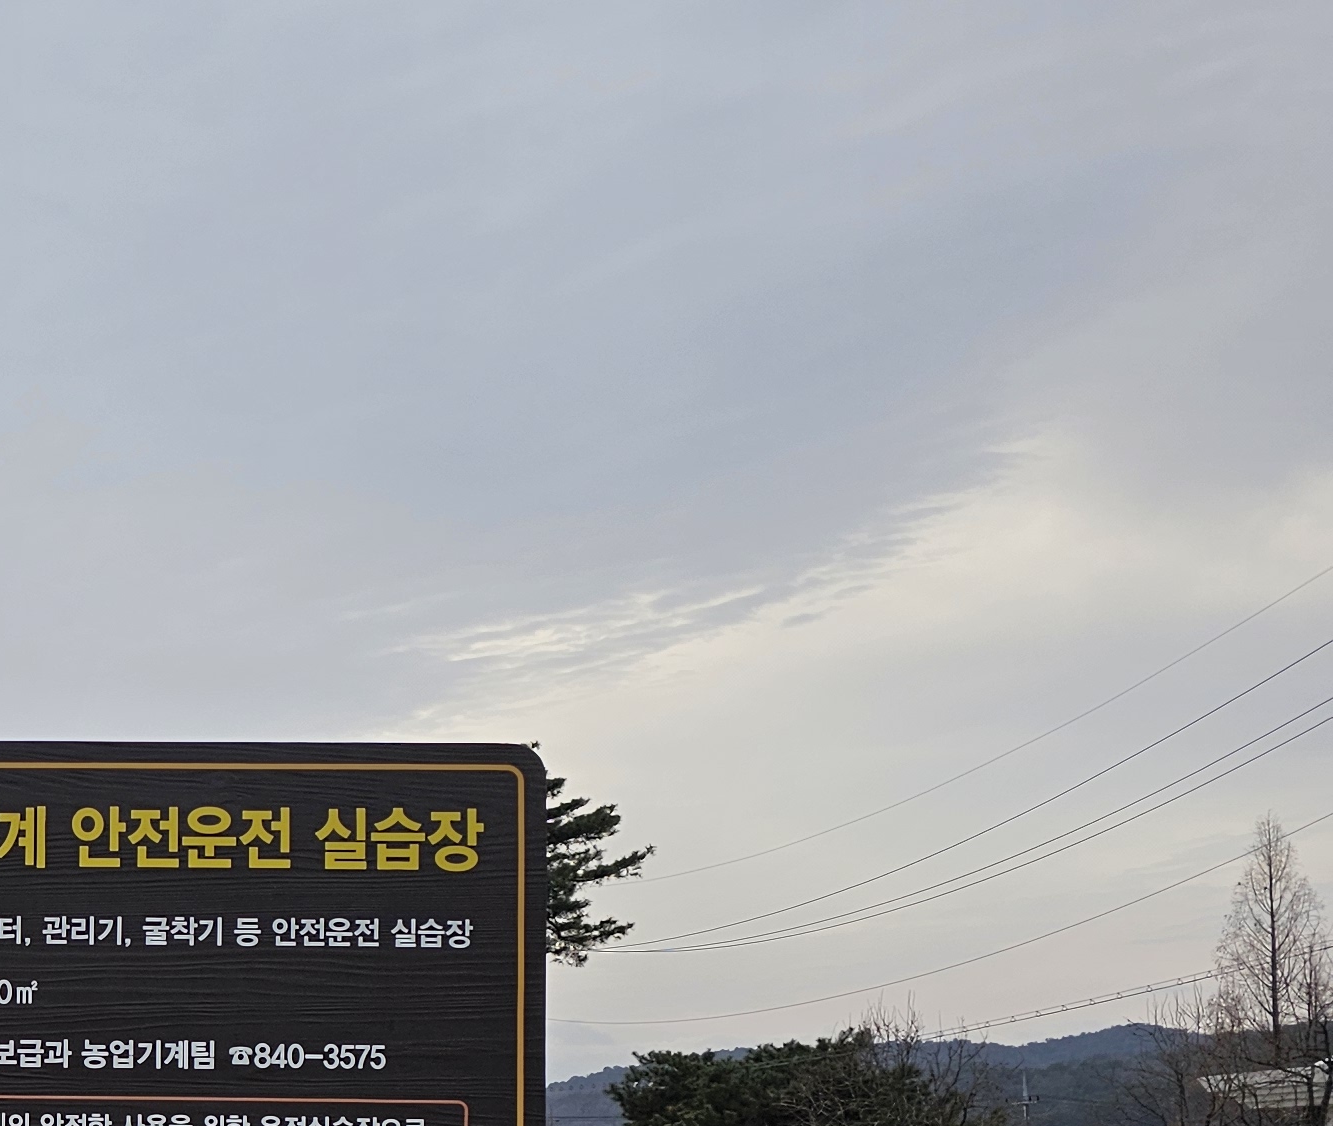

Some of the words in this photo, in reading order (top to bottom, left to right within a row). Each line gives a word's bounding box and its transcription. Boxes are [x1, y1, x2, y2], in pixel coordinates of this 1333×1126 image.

[71, 805, 291, 869] 안전운전
[315, 807, 485, 872] 실습장
[42, 915, 132, 948] 관리기,
[142, 916, 223, 947] 굴착기
[233, 917, 262, 947] 등
[272, 917, 380, 947] 안전운전
[390, 918, 474, 949] 실습장
[80, 1039, 215, 1070] 농업기계팀
